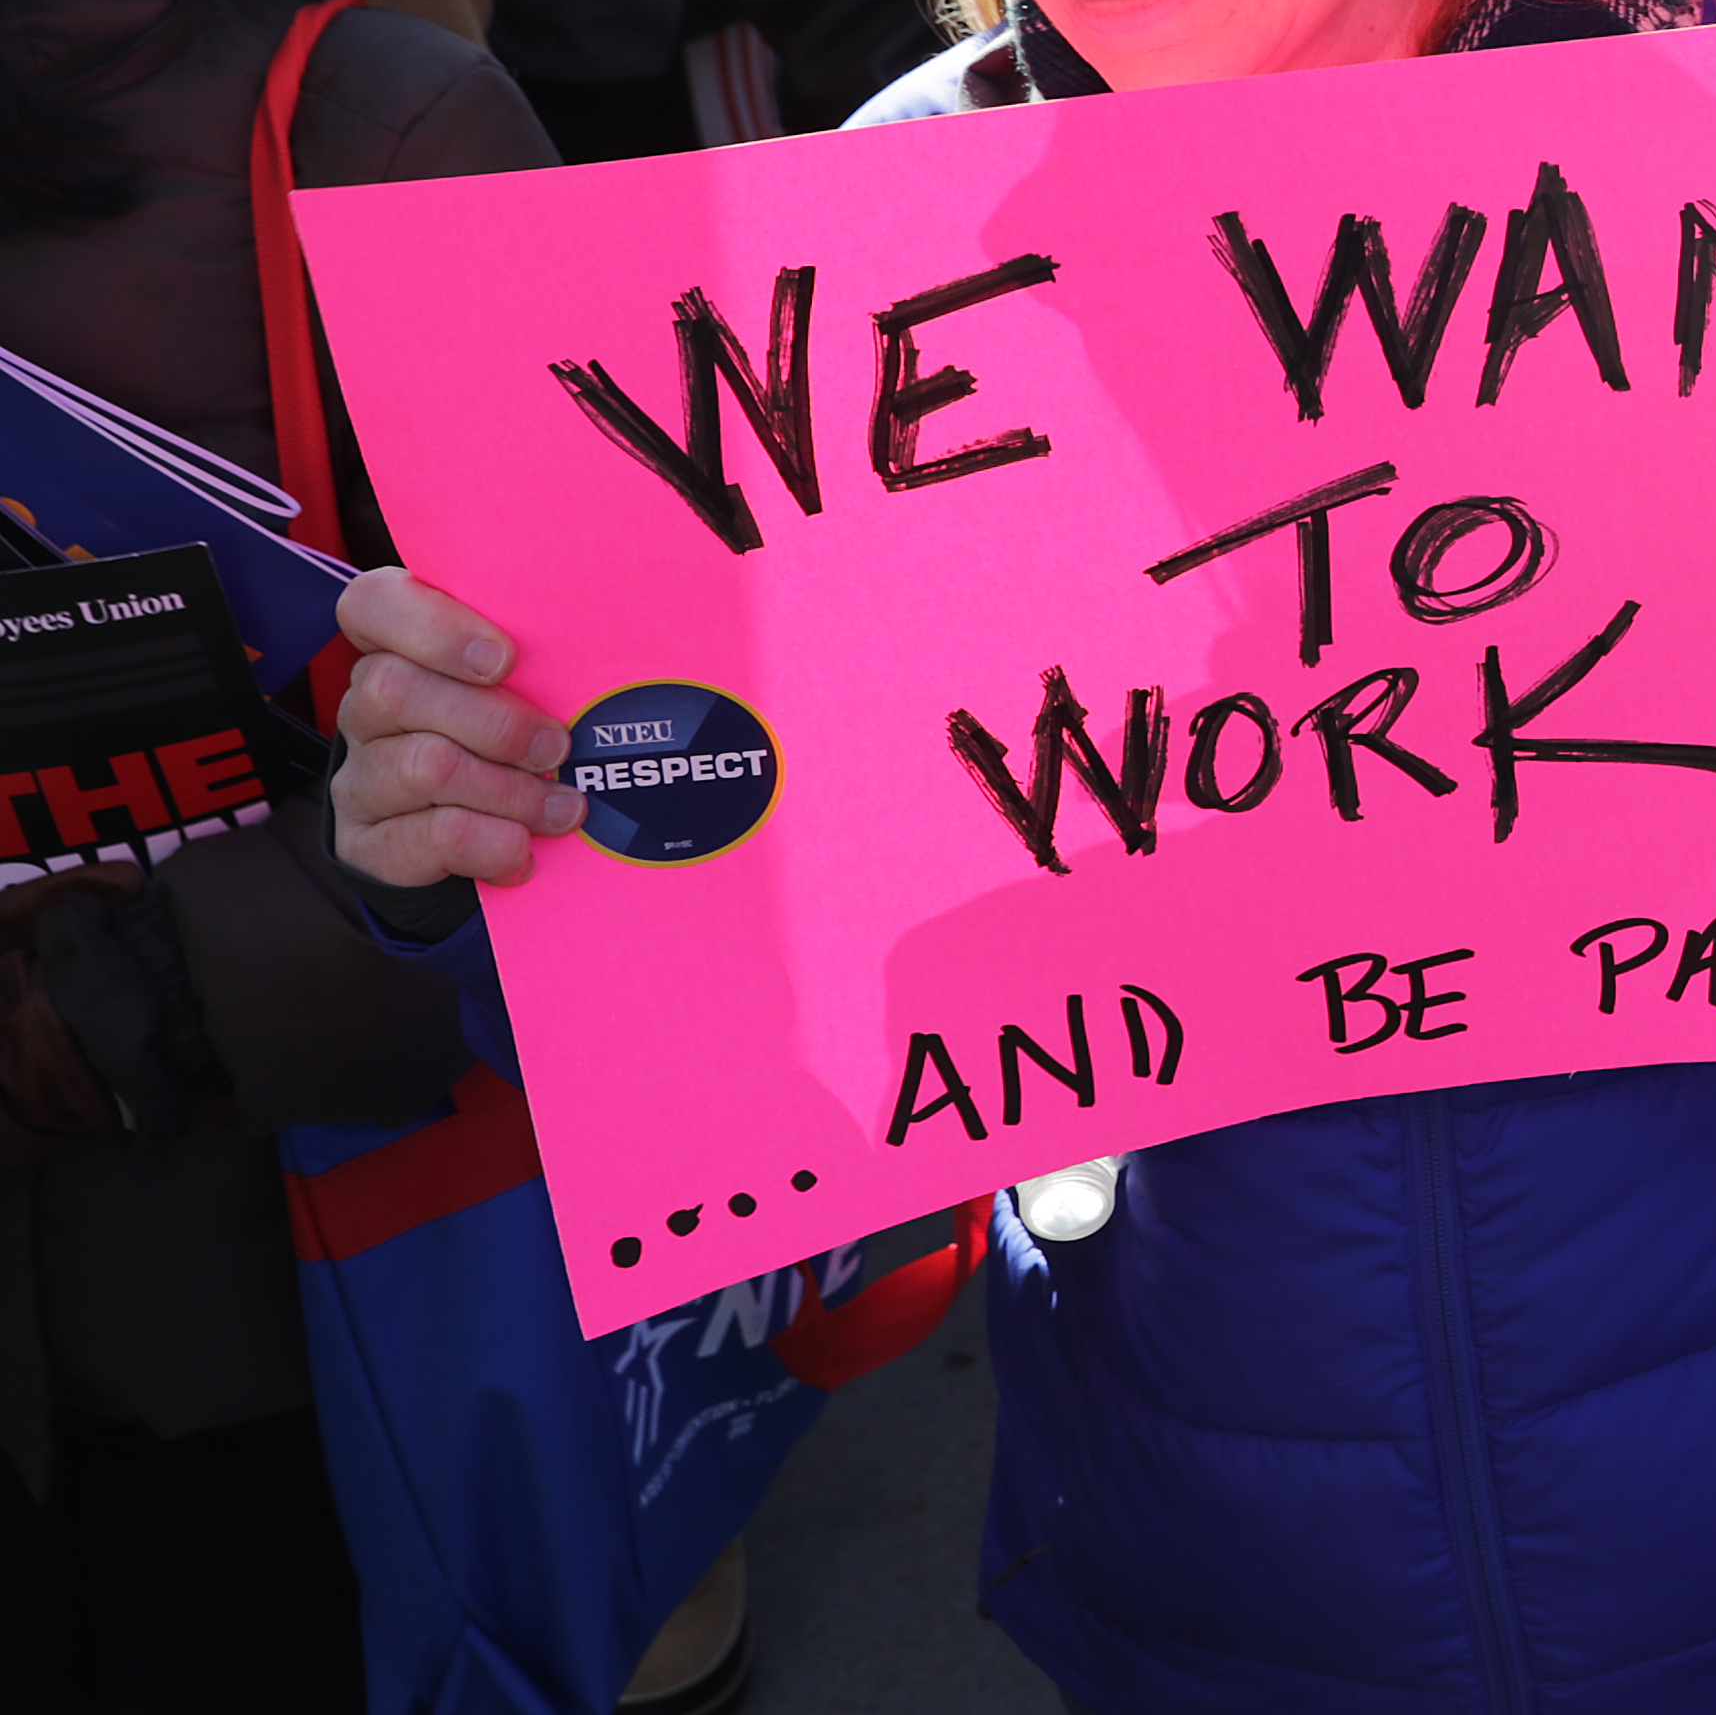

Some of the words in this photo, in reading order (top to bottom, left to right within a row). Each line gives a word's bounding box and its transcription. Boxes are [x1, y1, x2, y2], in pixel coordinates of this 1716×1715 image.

[547, 250, 1061, 556] WE
[1143, 459, 1560, 669] TO
[0, 609, 76, 642] yees
[76, 592, 187, 625] Union
[574, 749, 768, 793] RESPECT
[592, 719, 675, 748] NTEU
[1296, 947, 1477, 1056] BE
